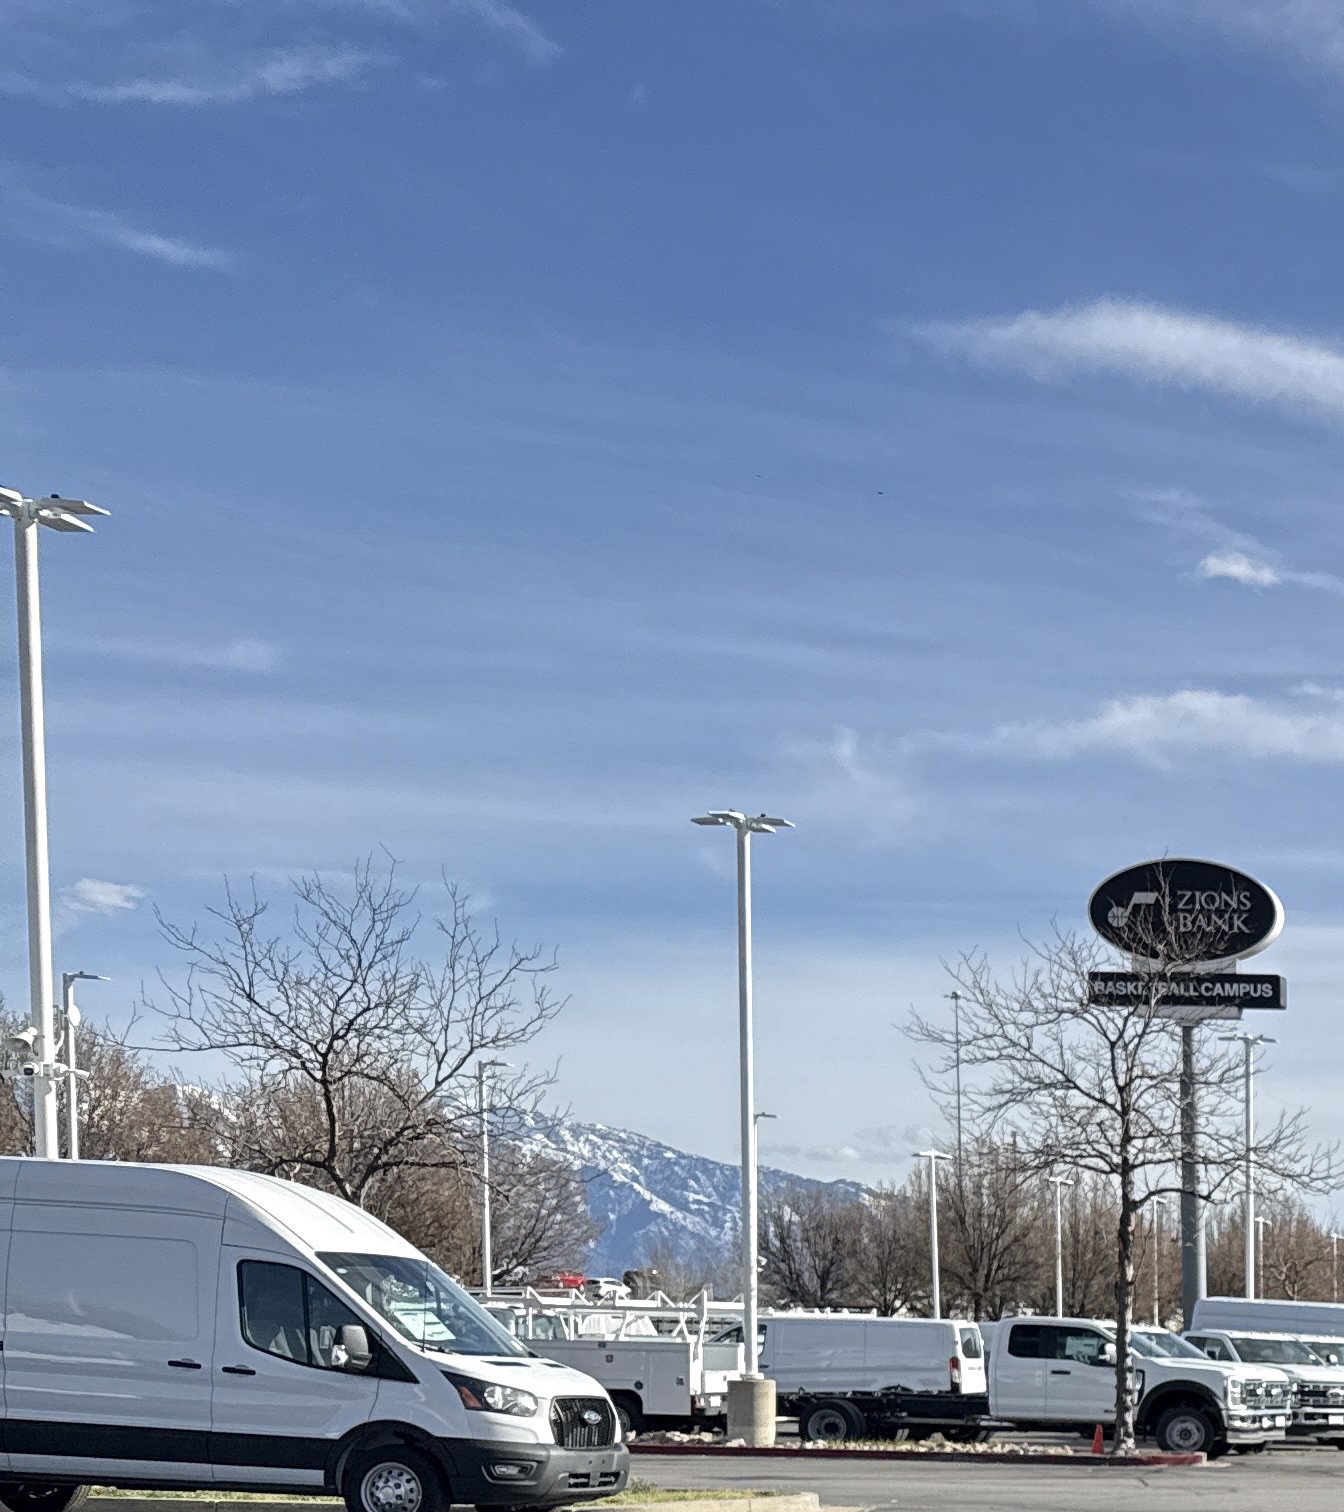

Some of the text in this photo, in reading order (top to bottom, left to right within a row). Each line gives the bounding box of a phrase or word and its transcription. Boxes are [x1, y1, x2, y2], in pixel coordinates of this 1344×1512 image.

[1176, 890, 1252, 911] ZIONS
[1177, 911, 1251, 934] BANK
[1094, 979, 1273, 998] BASKEBALL CAMPUS
